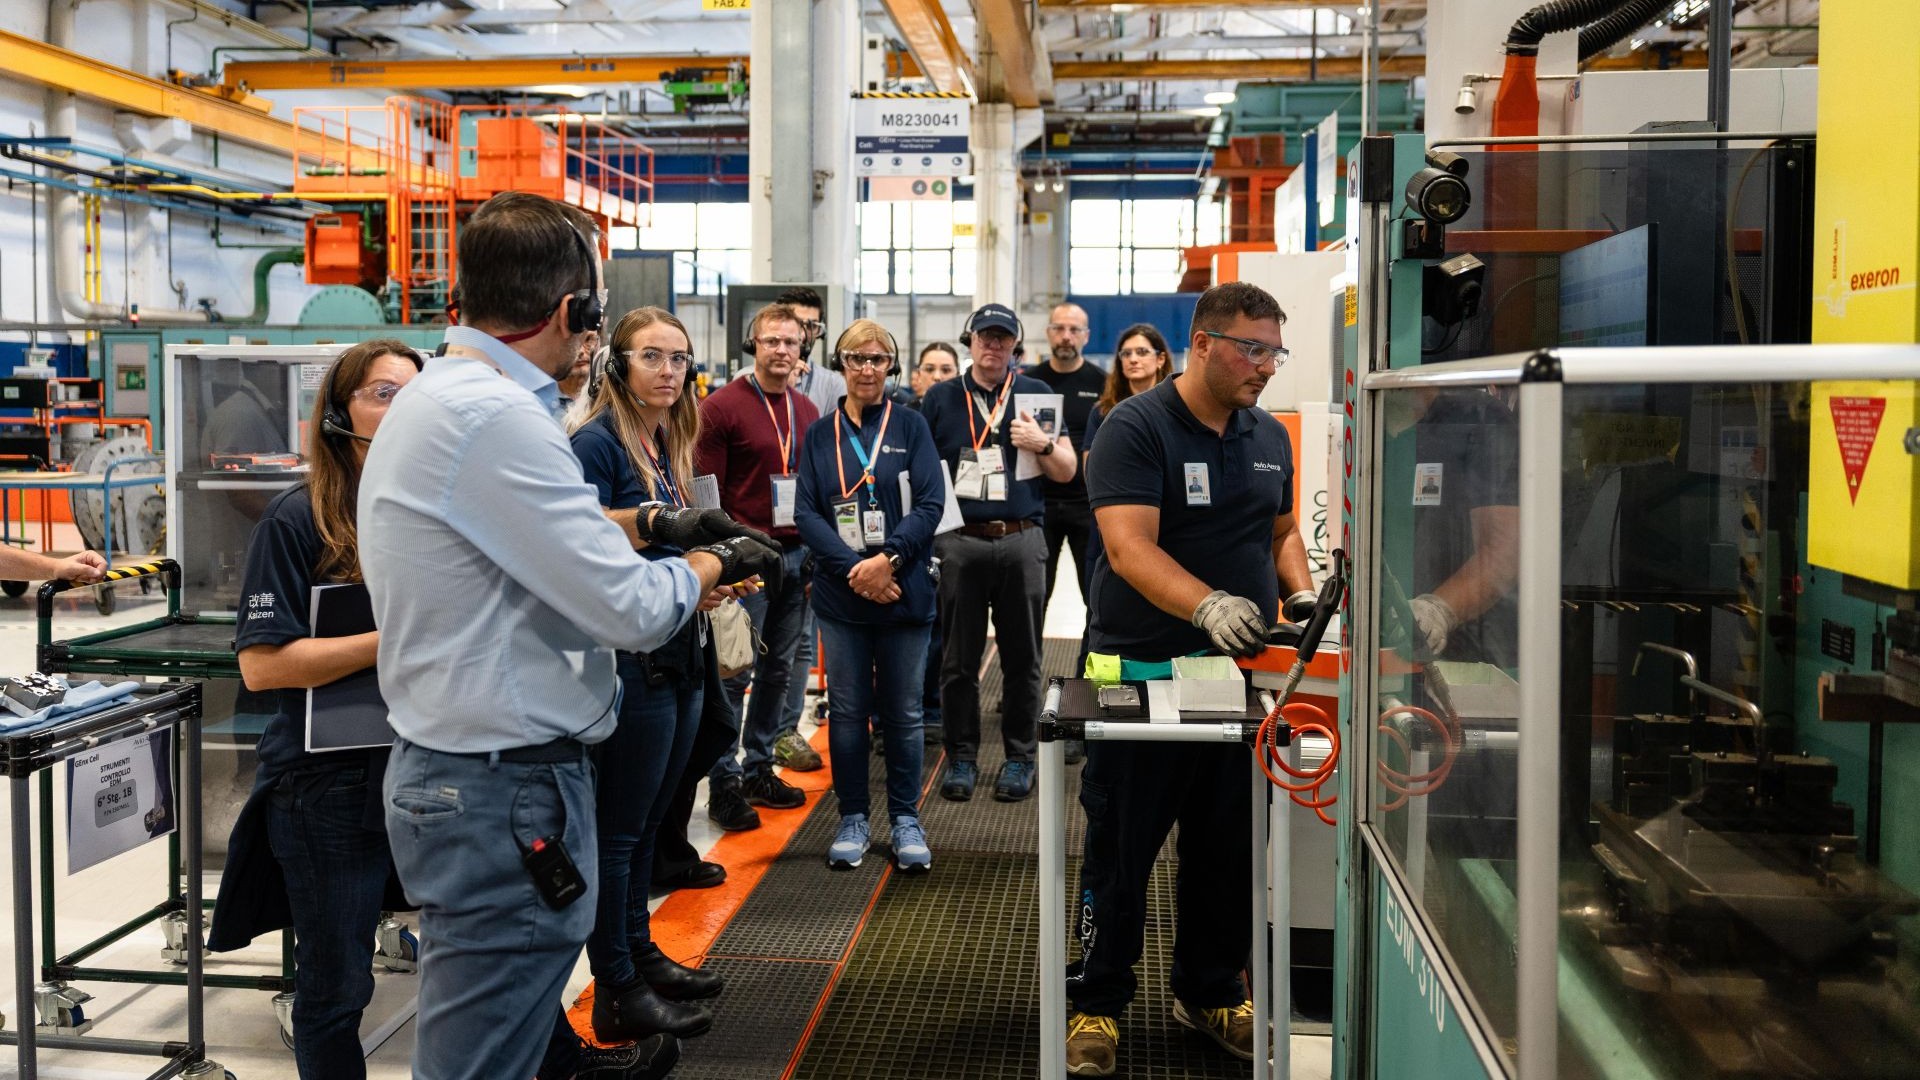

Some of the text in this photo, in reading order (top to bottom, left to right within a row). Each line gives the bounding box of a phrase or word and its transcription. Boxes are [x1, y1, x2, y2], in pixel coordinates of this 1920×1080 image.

[882, 114, 959, 127] M8230041
[1850, 266, 1900, 292] exeron
[248, 592, 275, 608] 改善
[248, 610, 274, 620] Kaizen
[74, 754, 100, 768] GEnx Cell
[100, 757, 131, 773] STRUMENTI
[100, 767, 131, 783] CONTROLLO
[109, 777, 122, 787] EDM
[107, 791, 121, 804] Stg.
[123, 786, 133, 798] 1B
[1386, 886, 1415, 975] EDM
